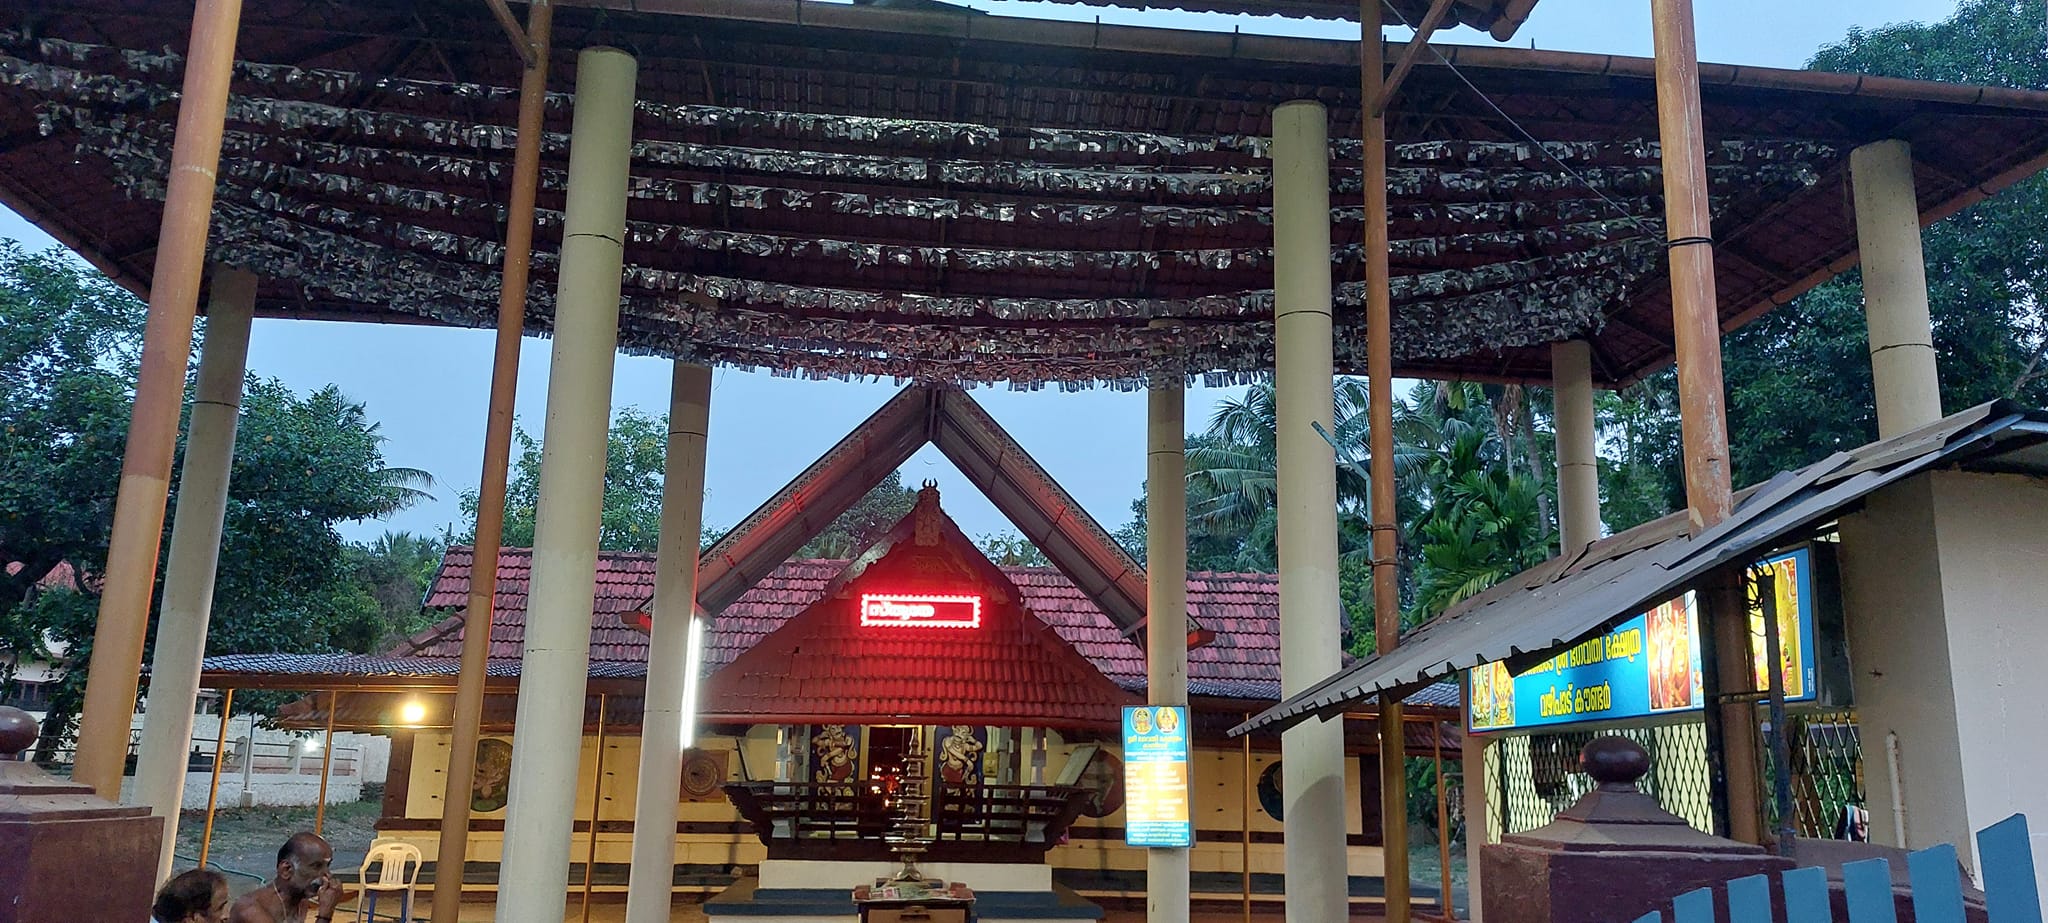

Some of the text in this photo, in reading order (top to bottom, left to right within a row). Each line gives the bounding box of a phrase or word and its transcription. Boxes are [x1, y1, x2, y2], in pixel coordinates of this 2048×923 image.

[1605, 628, 1641, 662] ക്ഷേത്ര
[1540, 679, 1611, 717] വഴിപാട് കൗണ്ടർ
